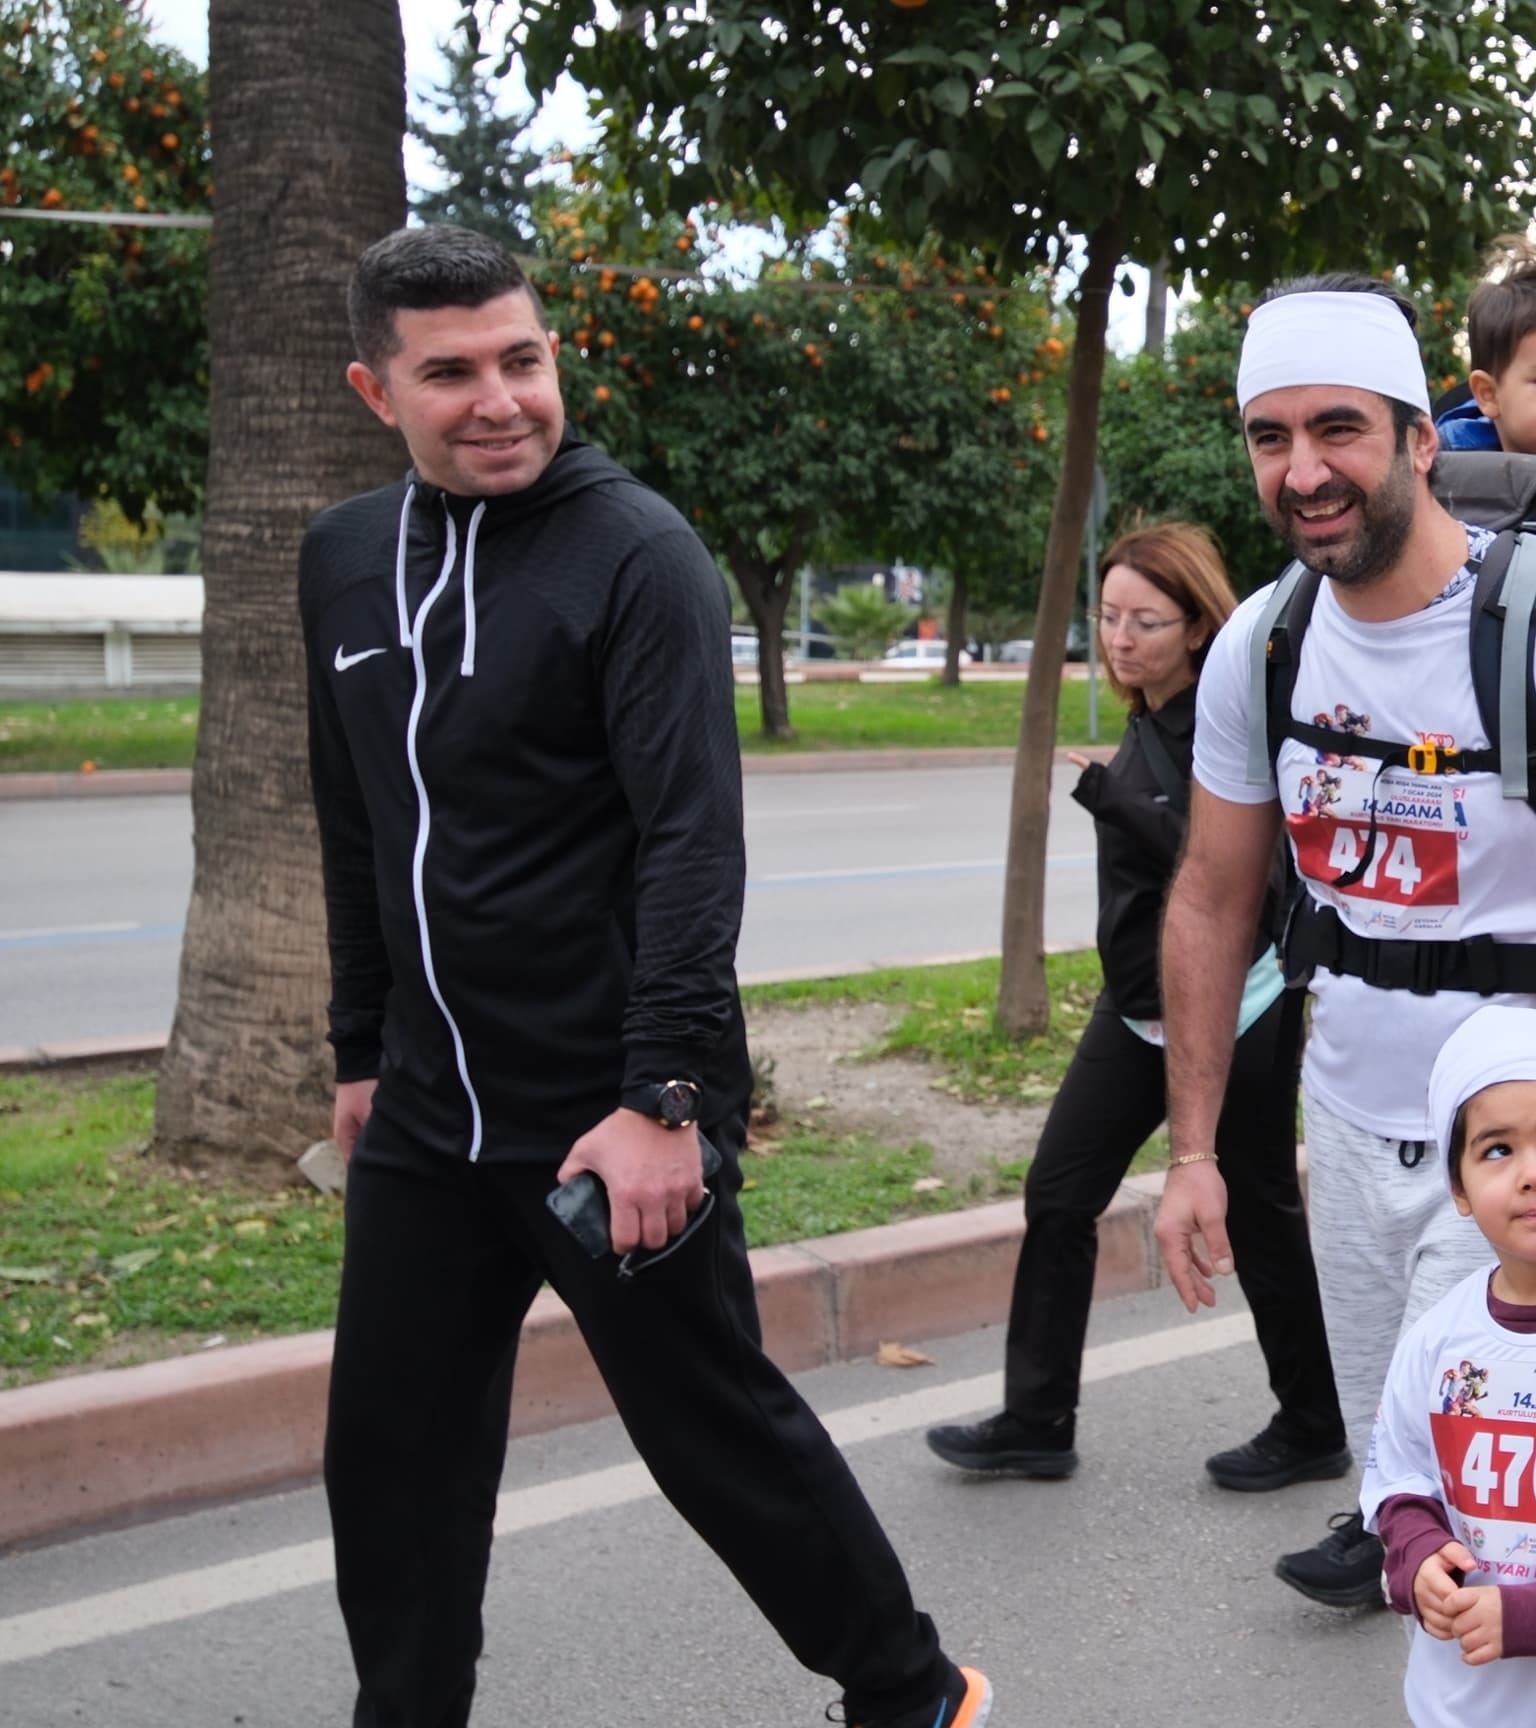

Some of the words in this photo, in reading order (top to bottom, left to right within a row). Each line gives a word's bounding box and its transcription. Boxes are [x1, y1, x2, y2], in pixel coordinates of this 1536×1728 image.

[1362, 798, 1443, 820] 14.ADANA
[1328, 827, 1422, 895] 474
[1496, 1562, 1530, 1577] YARI
